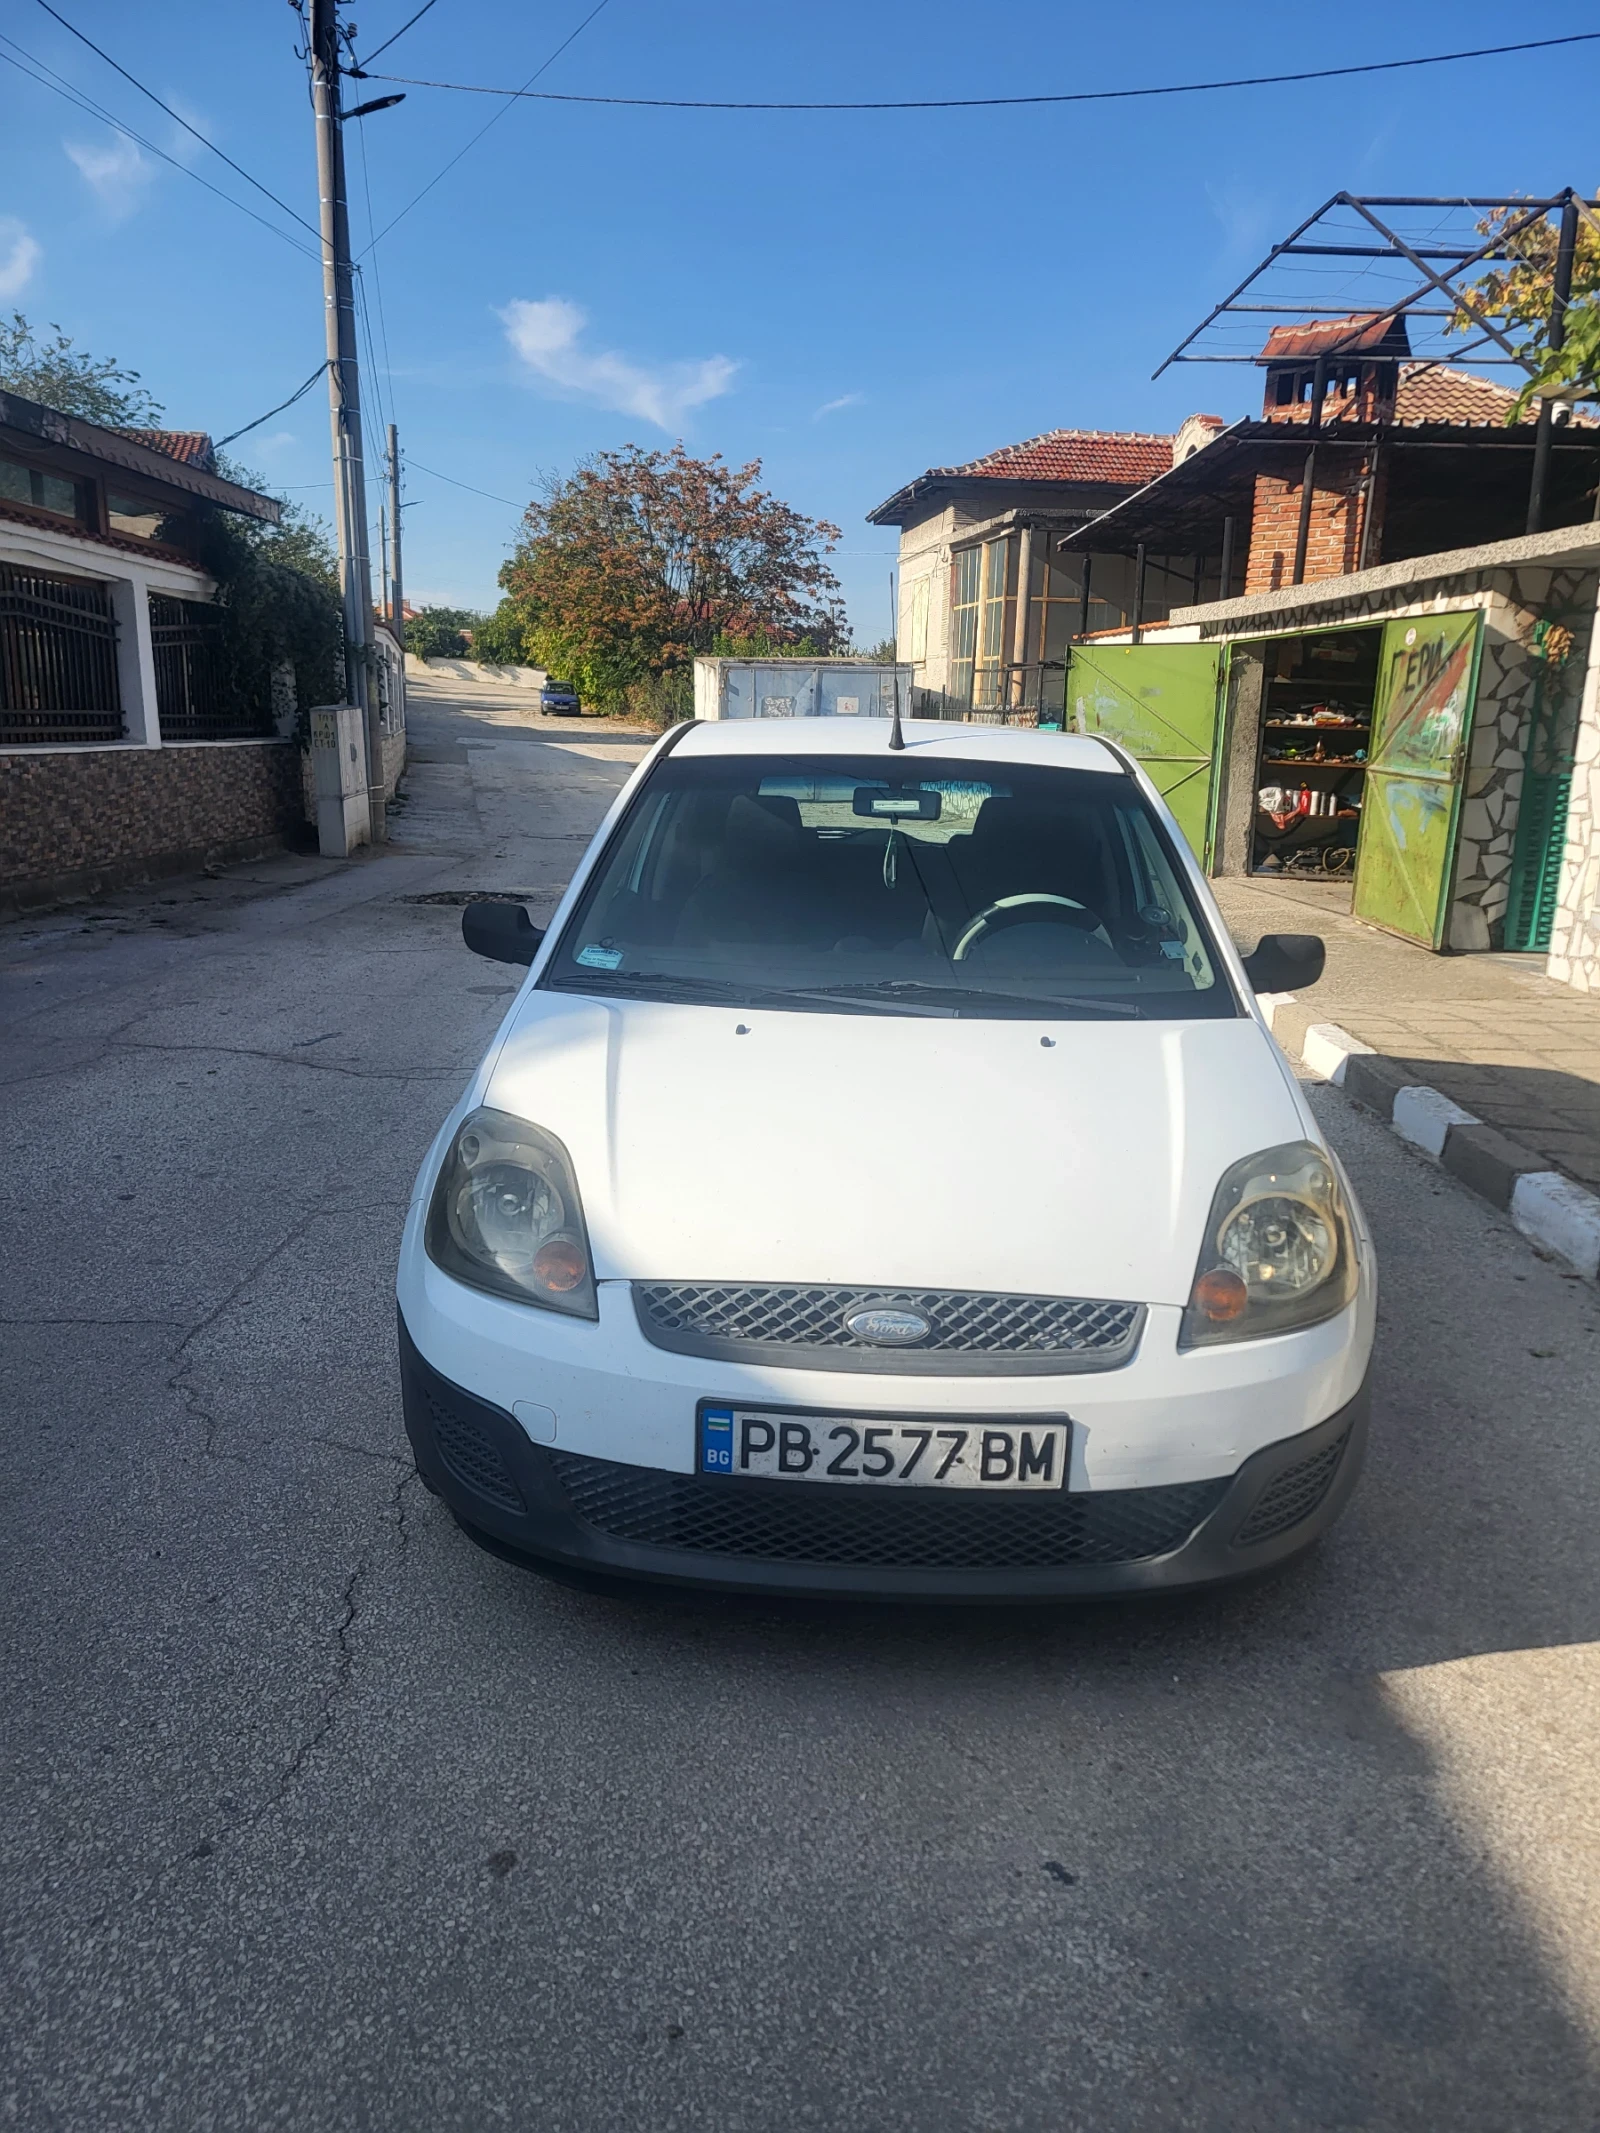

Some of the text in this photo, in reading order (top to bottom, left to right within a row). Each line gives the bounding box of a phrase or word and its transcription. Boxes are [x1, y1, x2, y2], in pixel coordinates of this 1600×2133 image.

[866, 1316, 910, 1336] Ford
[707, 1449, 730, 1466] BG
[826, 1426, 969, 1479] 2577
[980, 1431, 1055, 1482] BM
